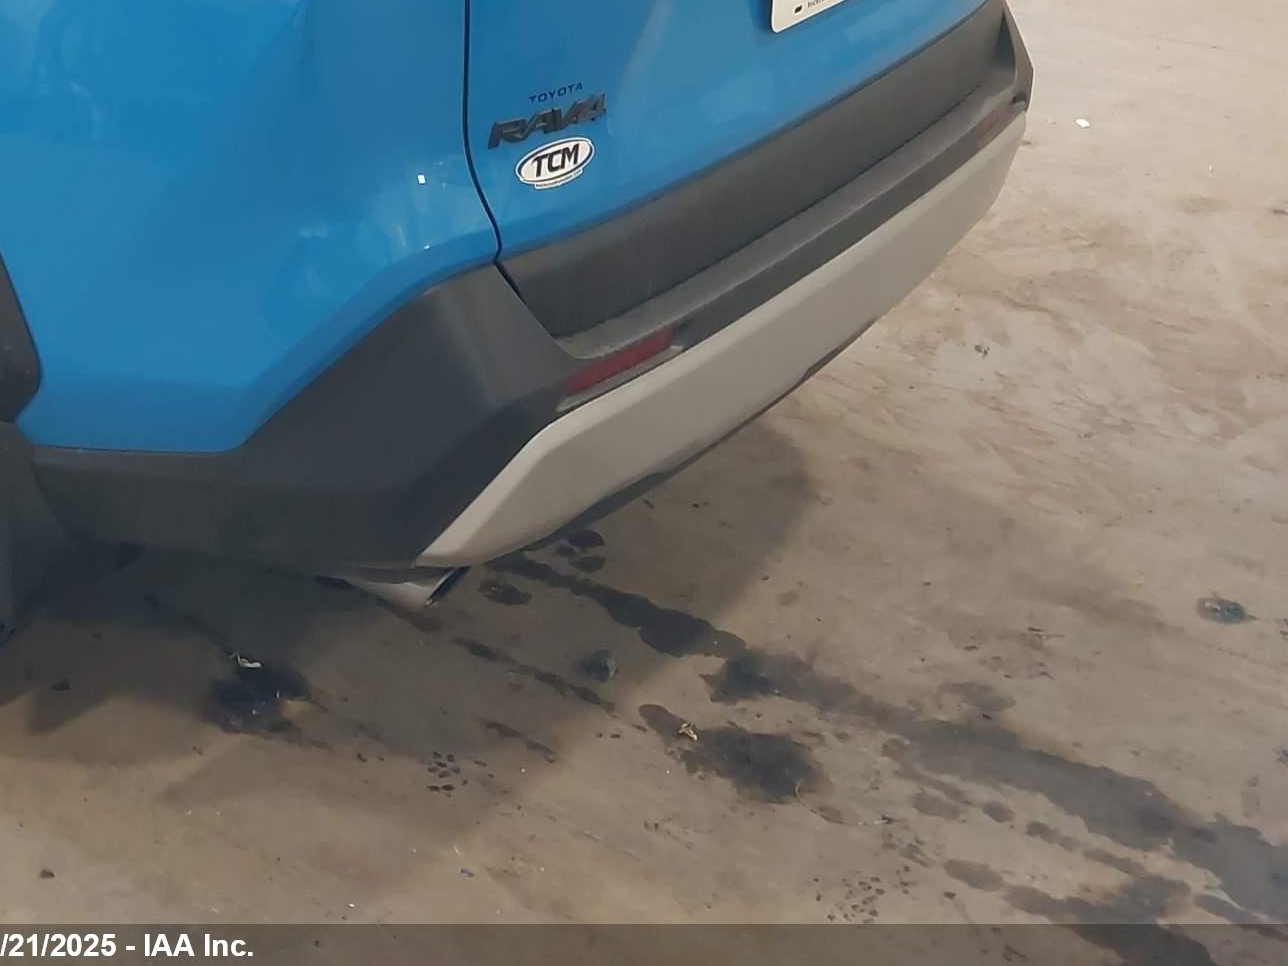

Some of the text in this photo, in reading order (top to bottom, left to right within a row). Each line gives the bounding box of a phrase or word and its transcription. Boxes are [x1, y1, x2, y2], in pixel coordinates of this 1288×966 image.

[529, 82, 584, 103] TOYOTA
[488, 90, 606, 149] RAV4
[532, 143, 580, 177] TCM
